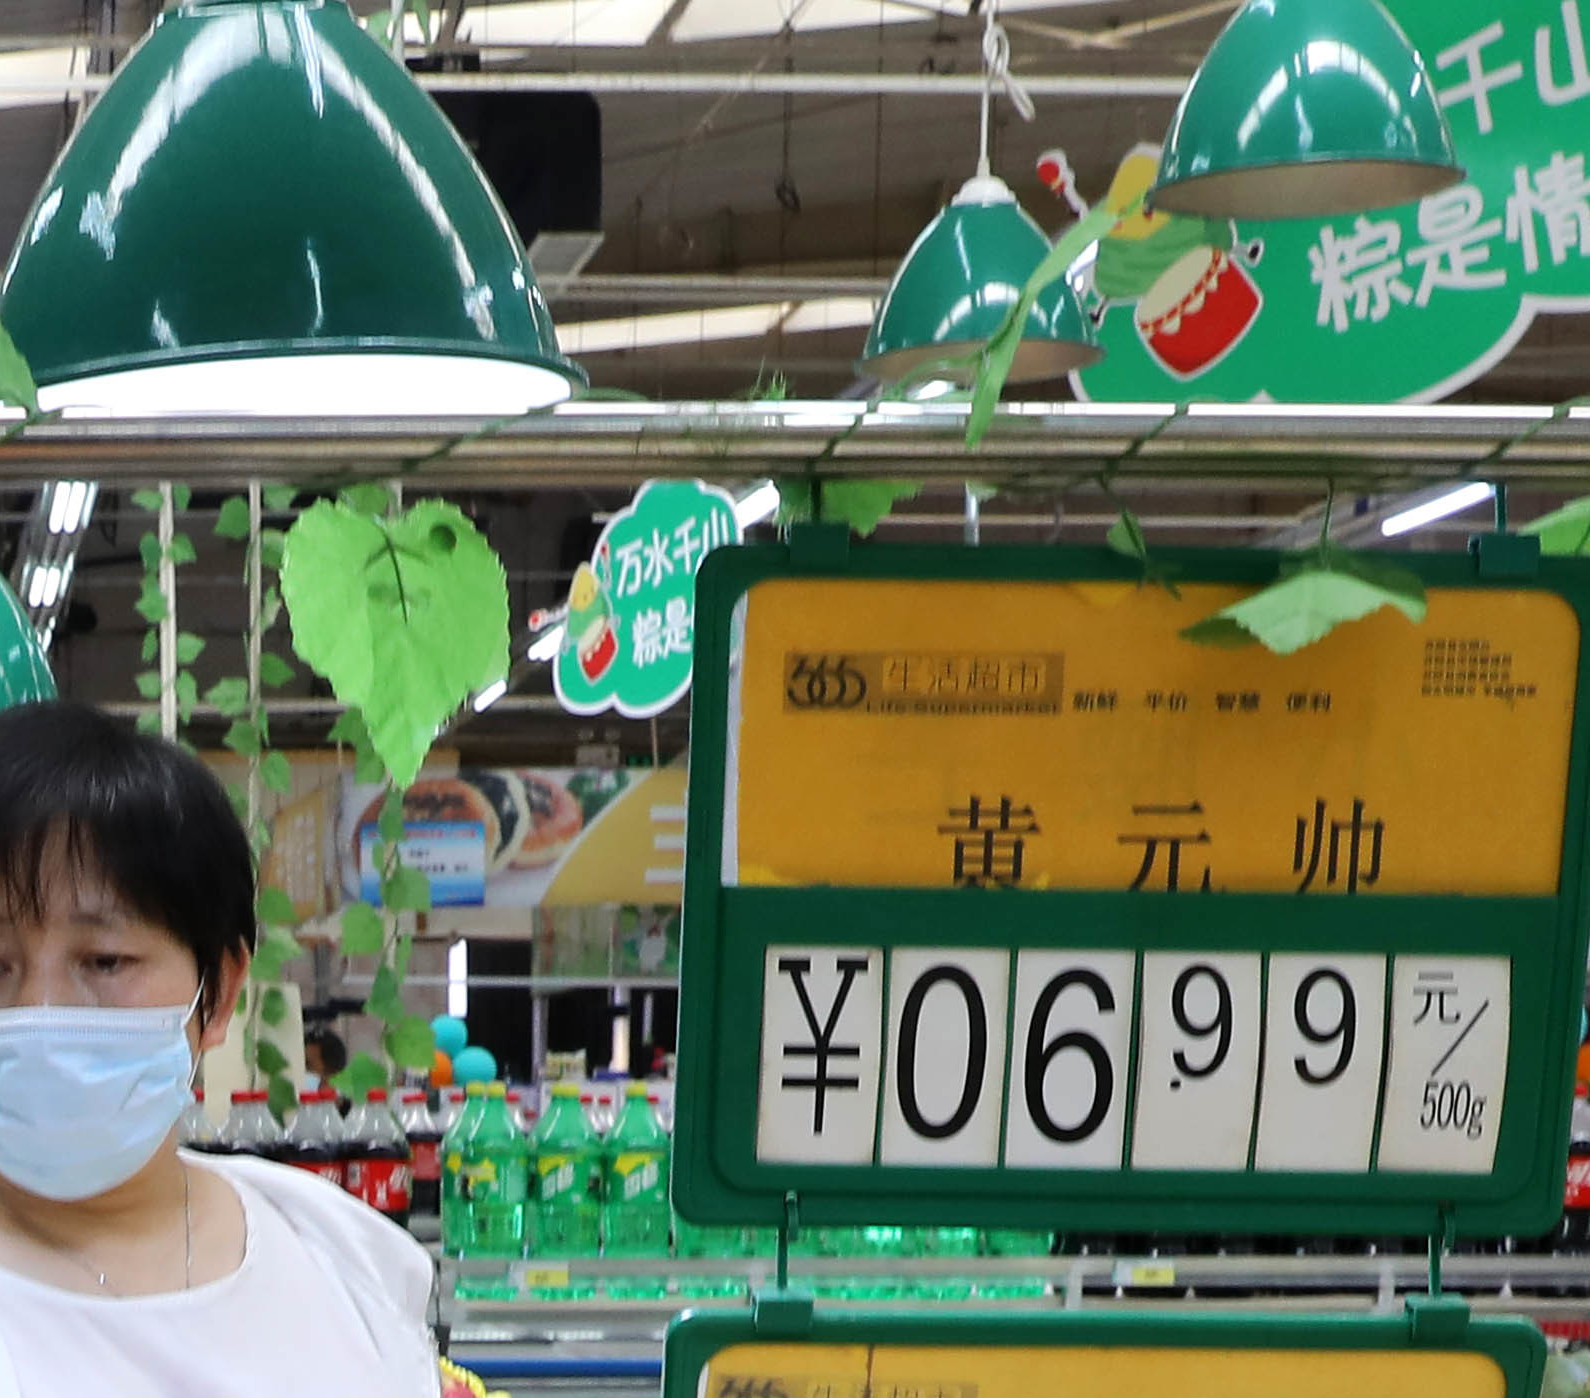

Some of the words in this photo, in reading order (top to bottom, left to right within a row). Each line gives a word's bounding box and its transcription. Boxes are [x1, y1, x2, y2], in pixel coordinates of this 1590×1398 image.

[882, 658, 1046, 694] 生活超市
[1145, 690, 1188, 711] 平价
